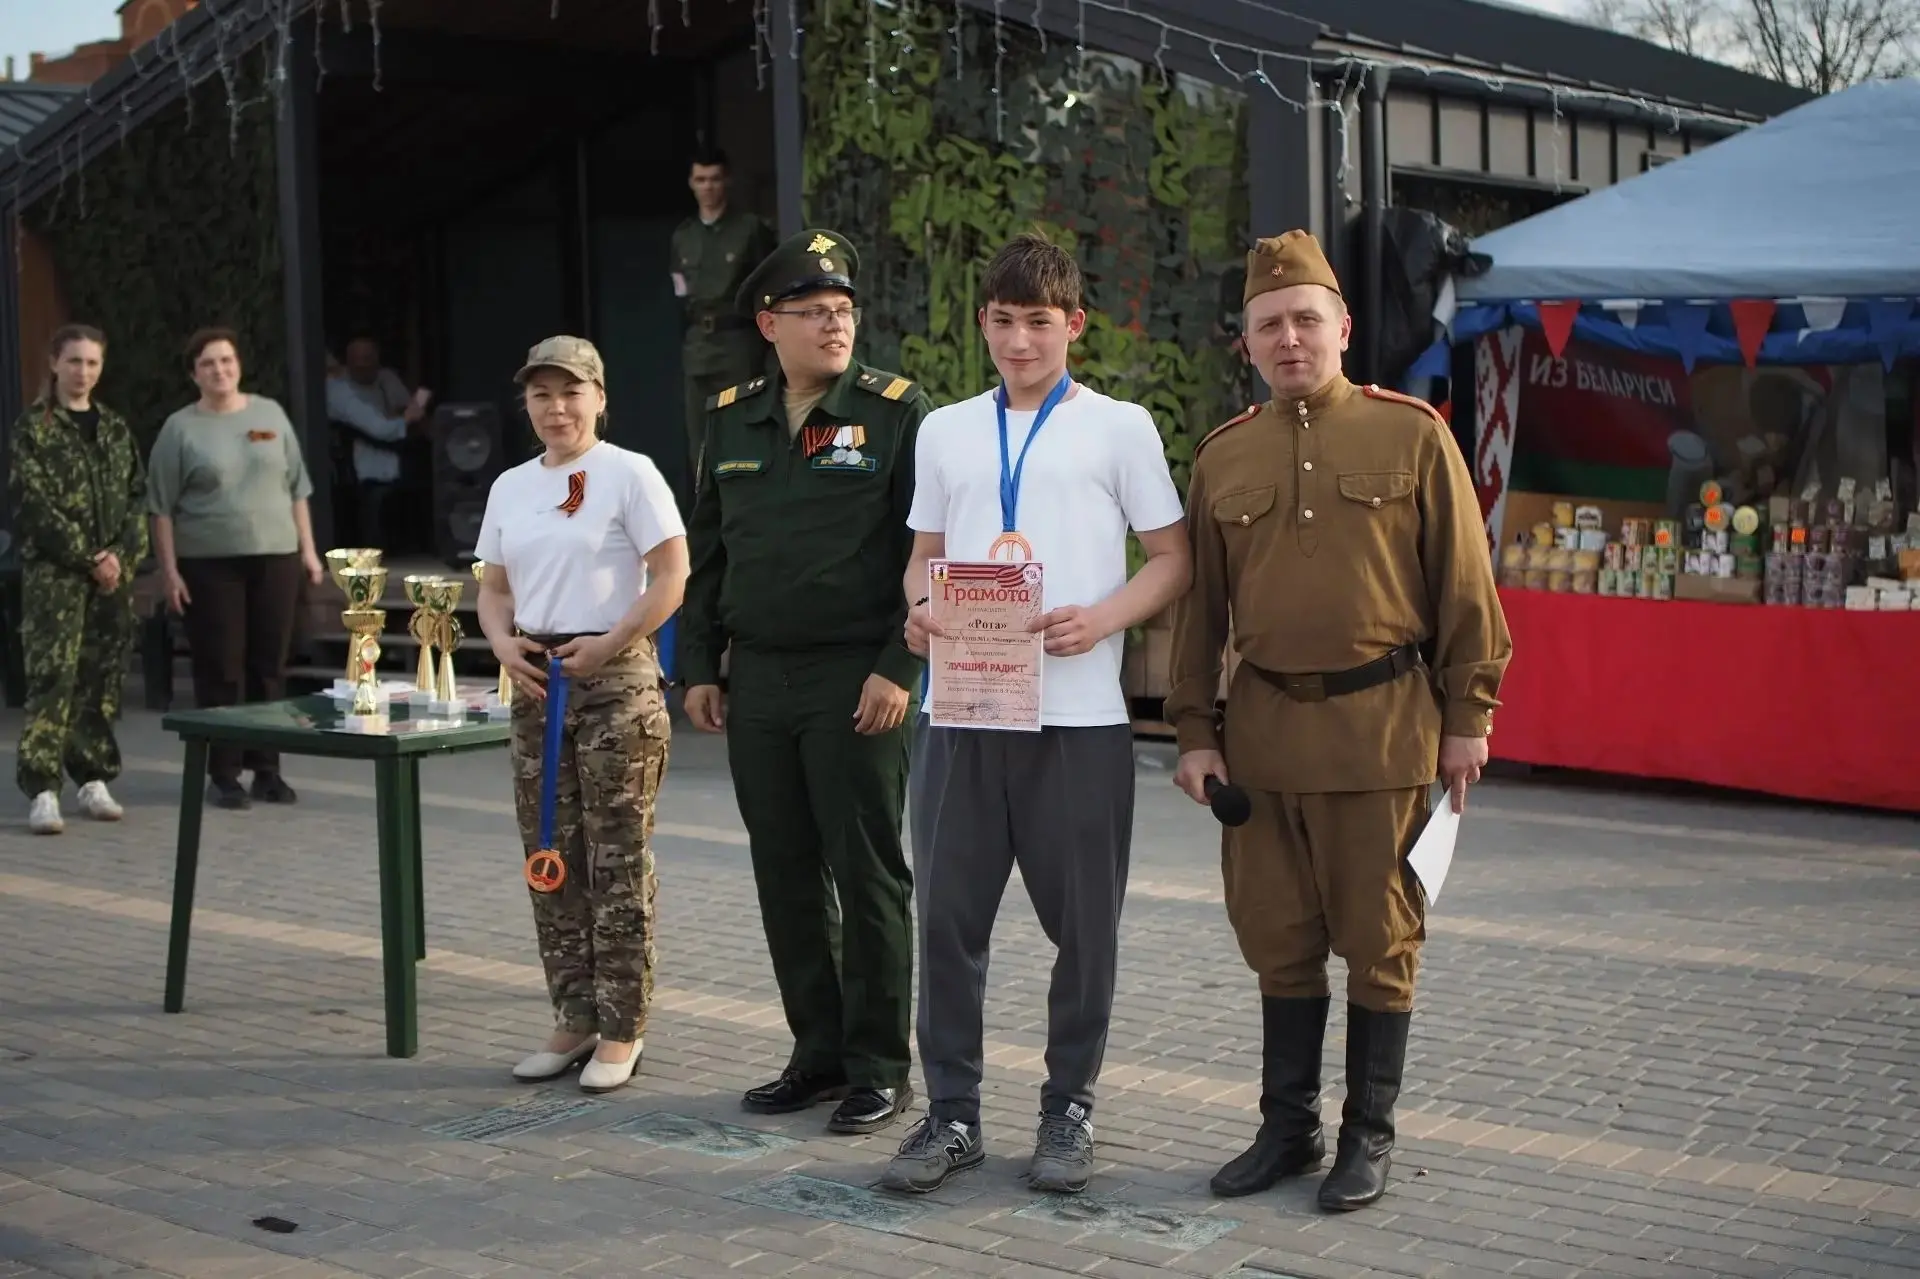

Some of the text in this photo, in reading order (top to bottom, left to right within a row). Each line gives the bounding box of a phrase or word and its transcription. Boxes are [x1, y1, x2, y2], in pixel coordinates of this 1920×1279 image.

[1529, 353, 1677, 405] ИЗ БЕЛАРУСИ
[943, 583, 1030, 606] Грамота
[968, 619, 1007, 630] «Рота»
